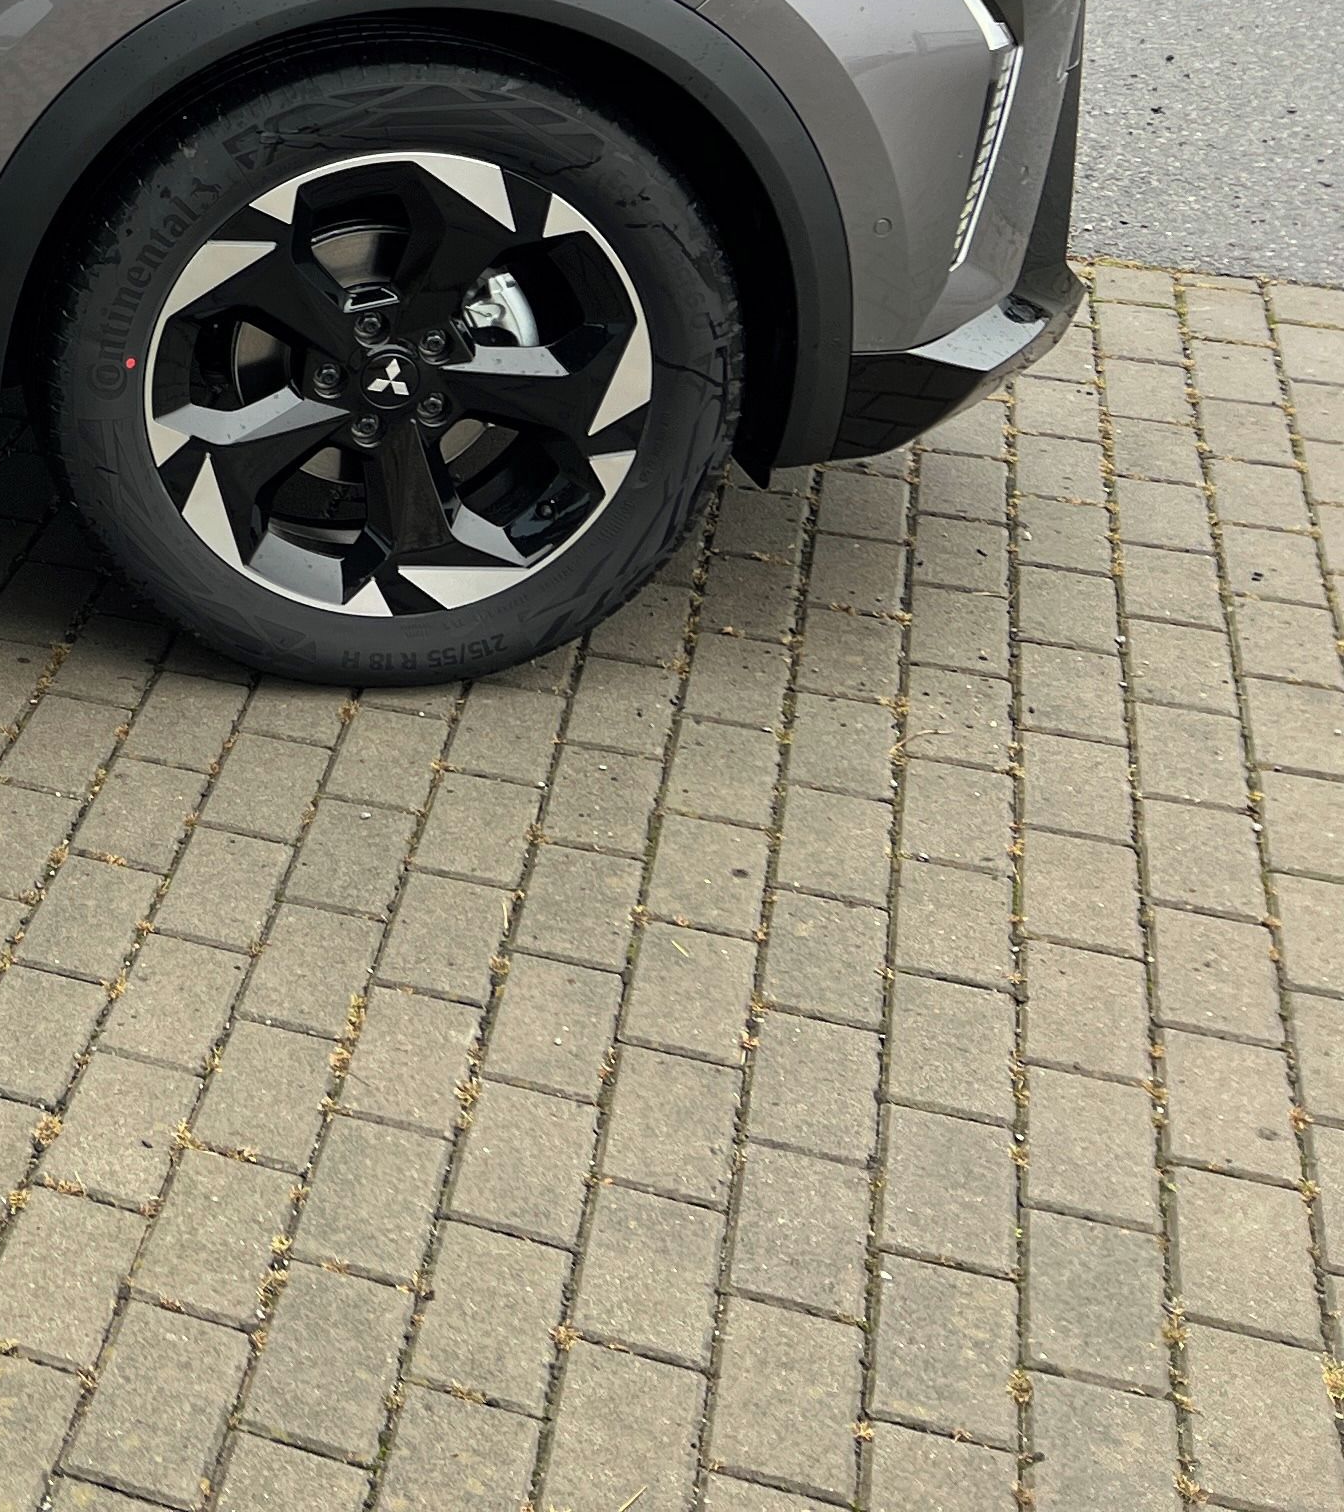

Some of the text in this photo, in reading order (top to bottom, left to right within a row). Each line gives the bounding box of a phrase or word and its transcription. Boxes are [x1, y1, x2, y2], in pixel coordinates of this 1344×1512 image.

[87, 195, 201, 401] Continental
[340, 650, 361, 670] H
[426, 633, 508, 669] 215/55
